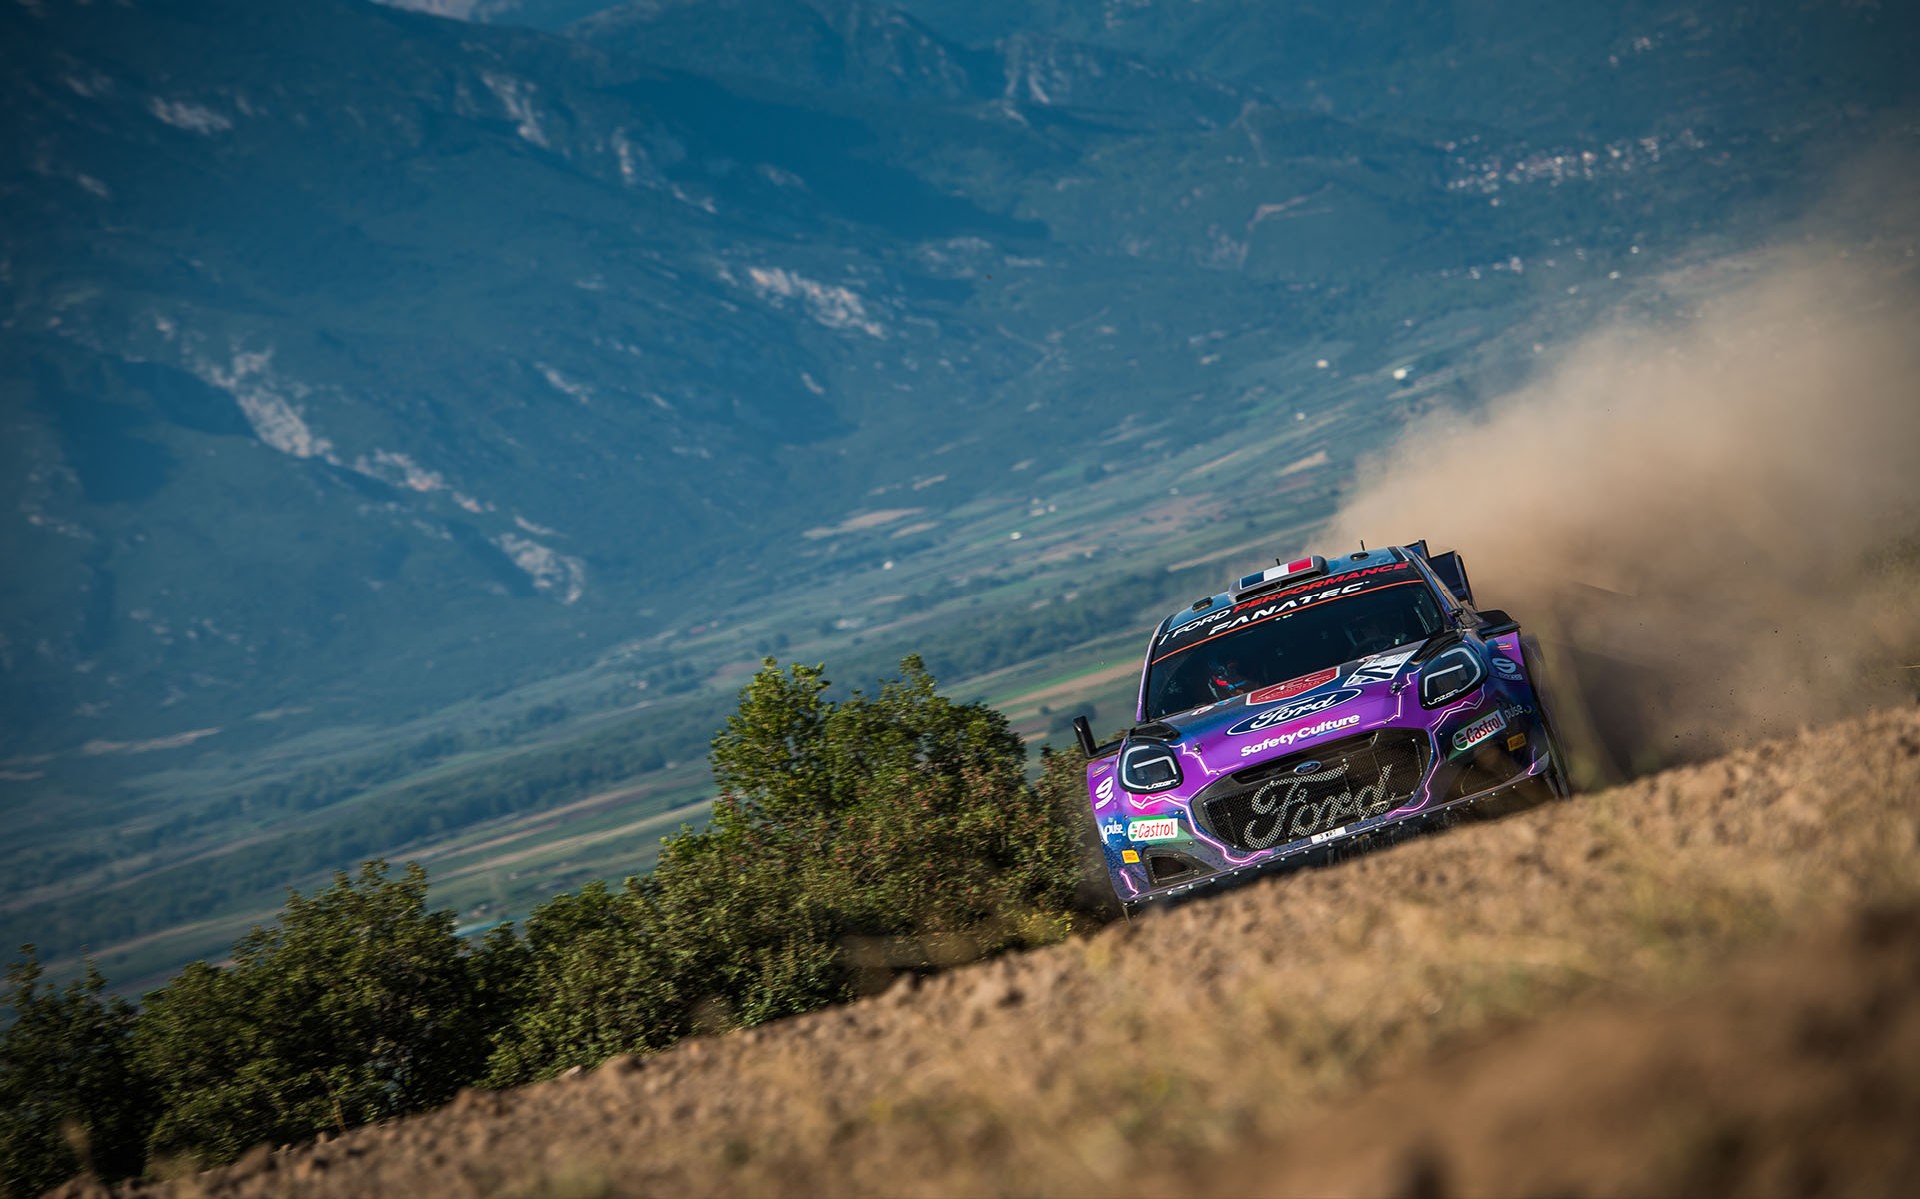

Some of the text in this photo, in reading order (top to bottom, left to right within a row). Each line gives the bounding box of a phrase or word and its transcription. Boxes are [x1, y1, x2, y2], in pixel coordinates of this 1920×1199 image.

[1172, 562, 1410, 639] FORD PERFORMANCE
[1208, 582, 1366, 636] FANATEC
[1250, 693, 1340, 730] Ford
[1465, 713, 1504, 743] Castrol
[1503, 703, 1524, 721] pulse
[1241, 714, 1361, 757] SafetyCulture
[1244, 763, 1396, 850] Ford
[1102, 820, 1175, 845] pulse Castrol
